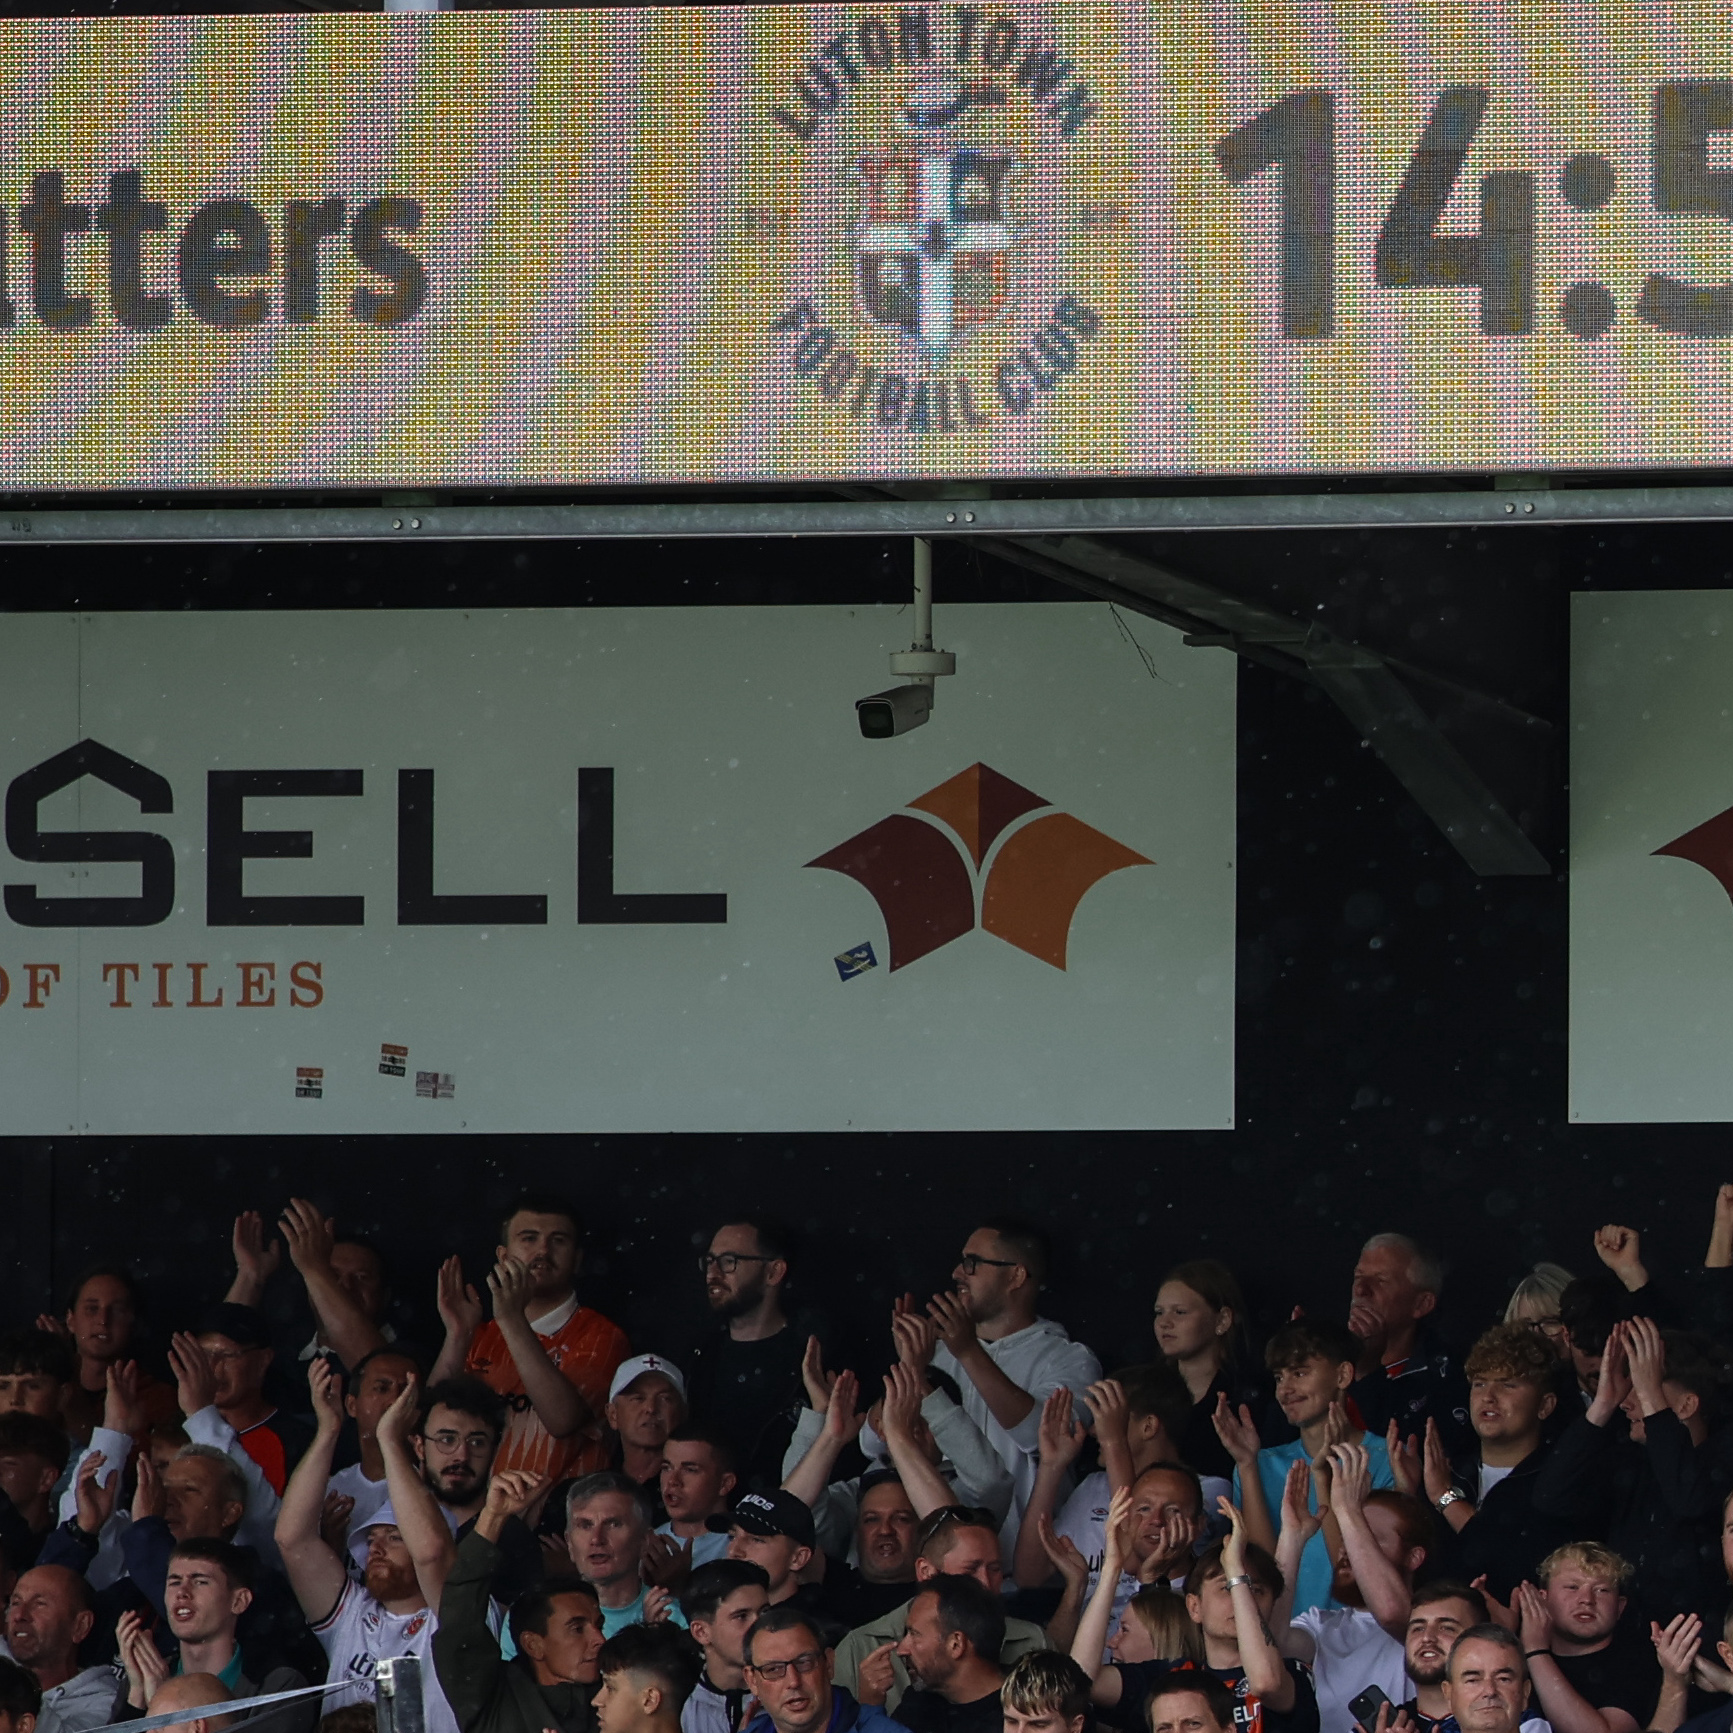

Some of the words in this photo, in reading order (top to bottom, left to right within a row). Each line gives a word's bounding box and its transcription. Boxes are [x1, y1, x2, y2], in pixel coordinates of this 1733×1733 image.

[771, 9, 931, 141] LUTON
[955, 8, 1096, 141] TOWN
[0, 168, 428, 331] tters
[104, 961, 324, 1009] TILES
